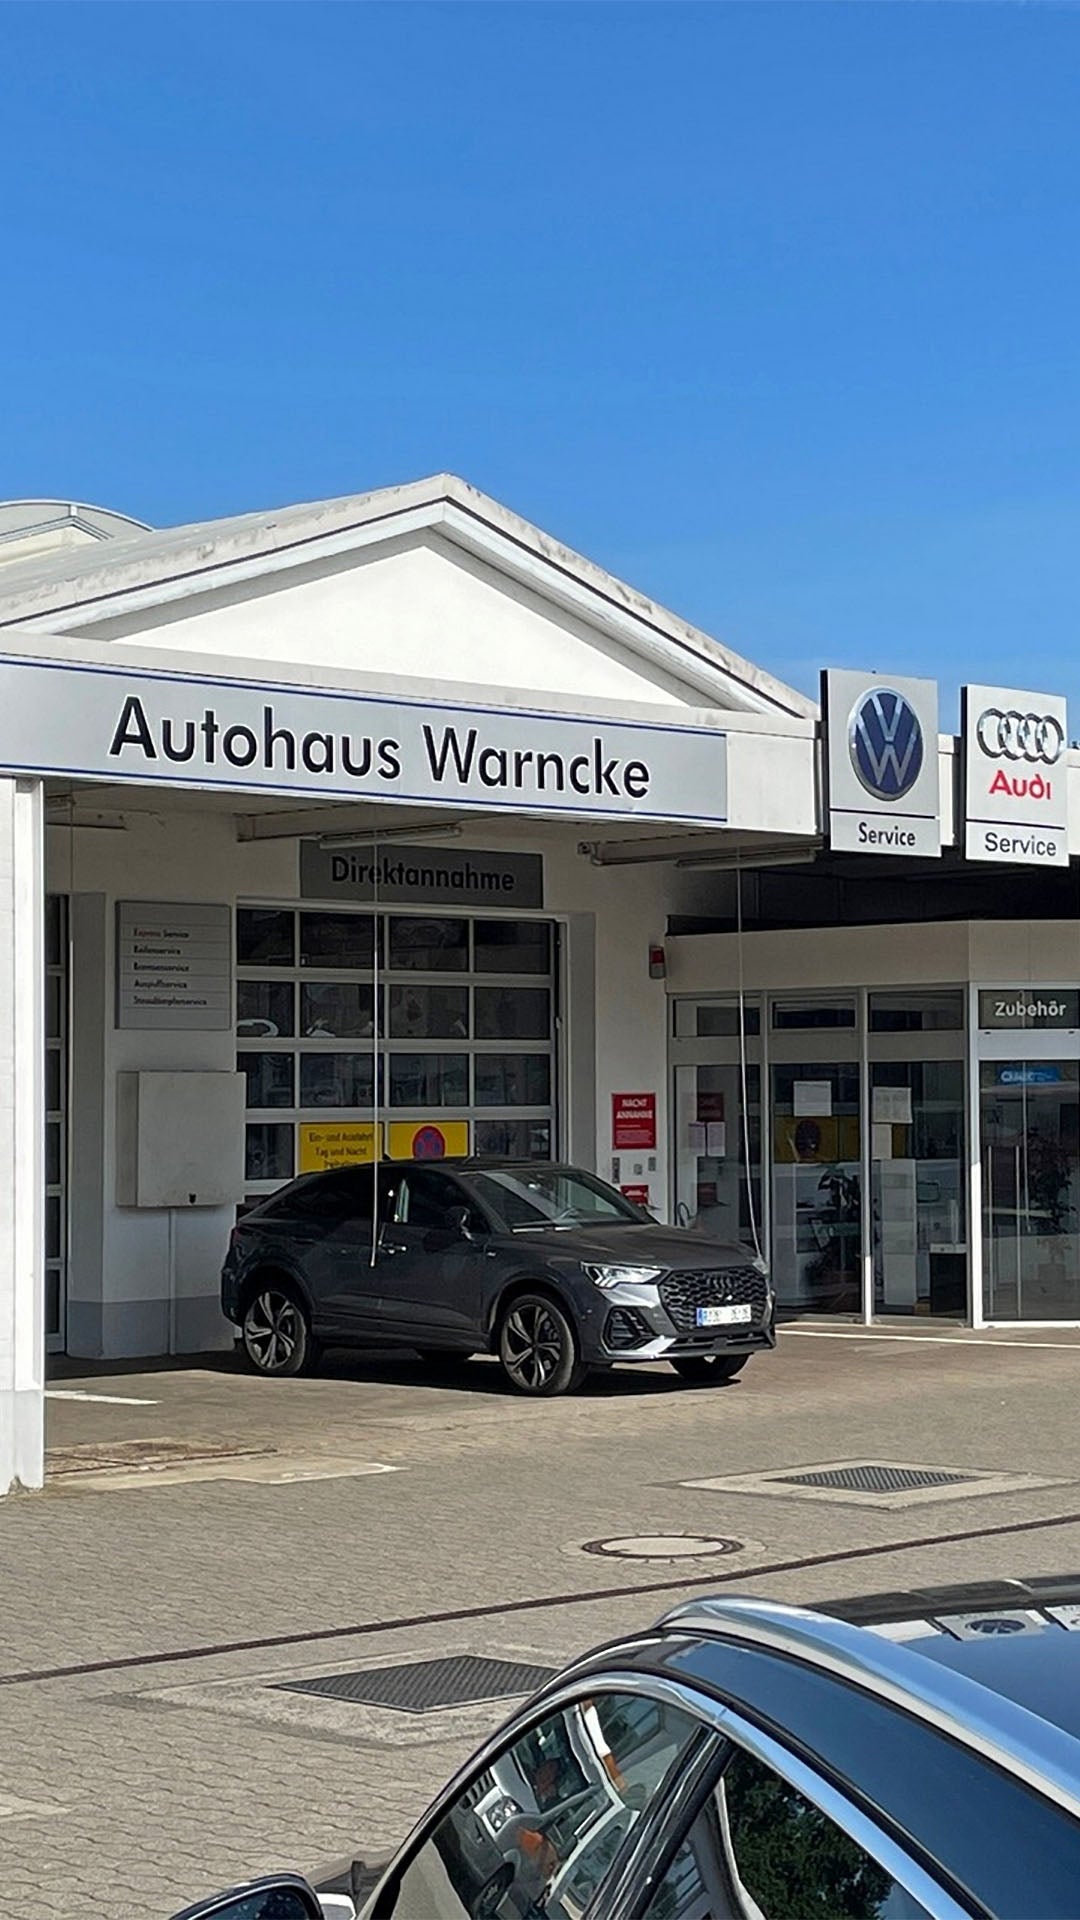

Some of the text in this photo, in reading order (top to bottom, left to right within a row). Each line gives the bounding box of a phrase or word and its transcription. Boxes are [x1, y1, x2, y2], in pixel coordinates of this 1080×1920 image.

[109, 696, 651, 799] Autohaus Warncke
[988, 770, 1051, 800] Audi
[858, 821, 916, 847] Service
[984, 832, 1057, 857] Service
[331, 855, 515, 892] Direktannahme
[994, 1000, 1067, 1017] Zubehör
[316, 1147, 367, 1159] Tag und Nacht
